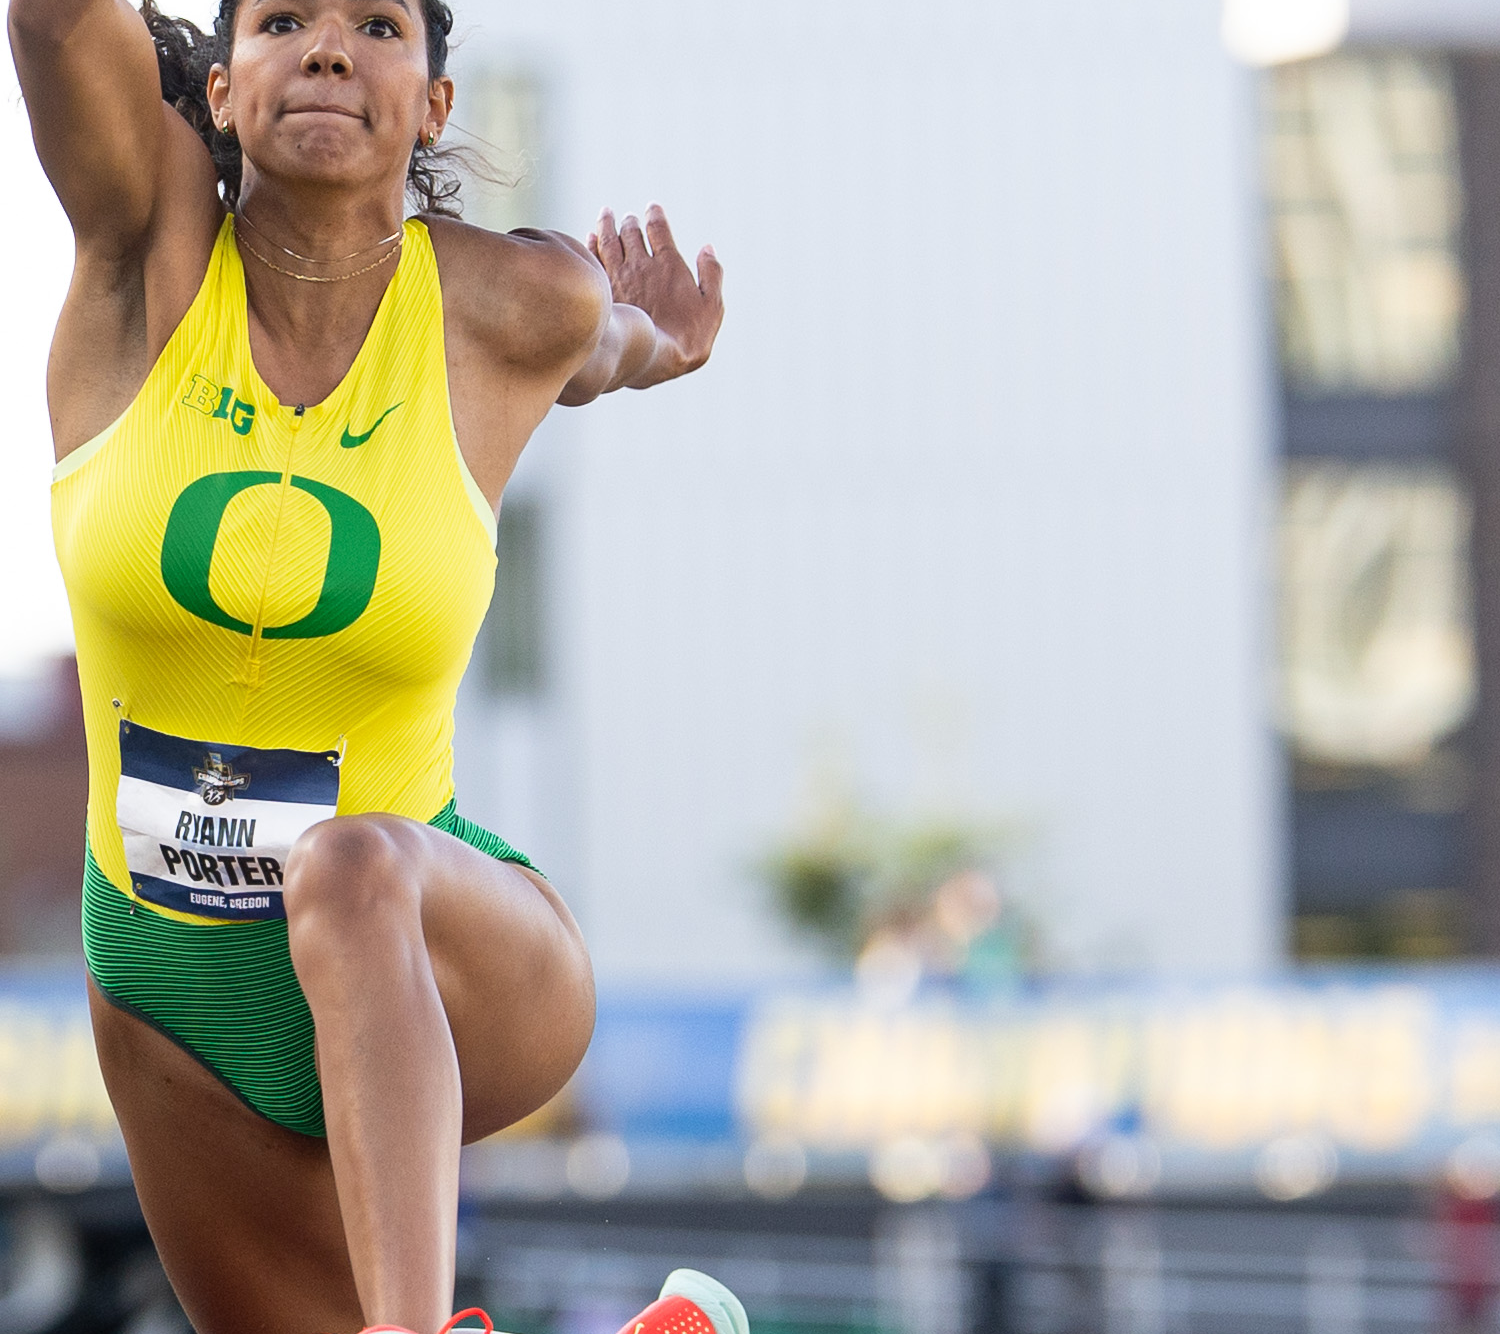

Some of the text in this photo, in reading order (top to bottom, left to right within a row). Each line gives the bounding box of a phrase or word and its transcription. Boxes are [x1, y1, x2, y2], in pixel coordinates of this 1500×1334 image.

[161, 470, 381, 639] O
[175, 811, 256, 847] RYANN
[159, 844, 283, 887] PORTER
[190, 892, 270, 909] EUGENE, OREGON
